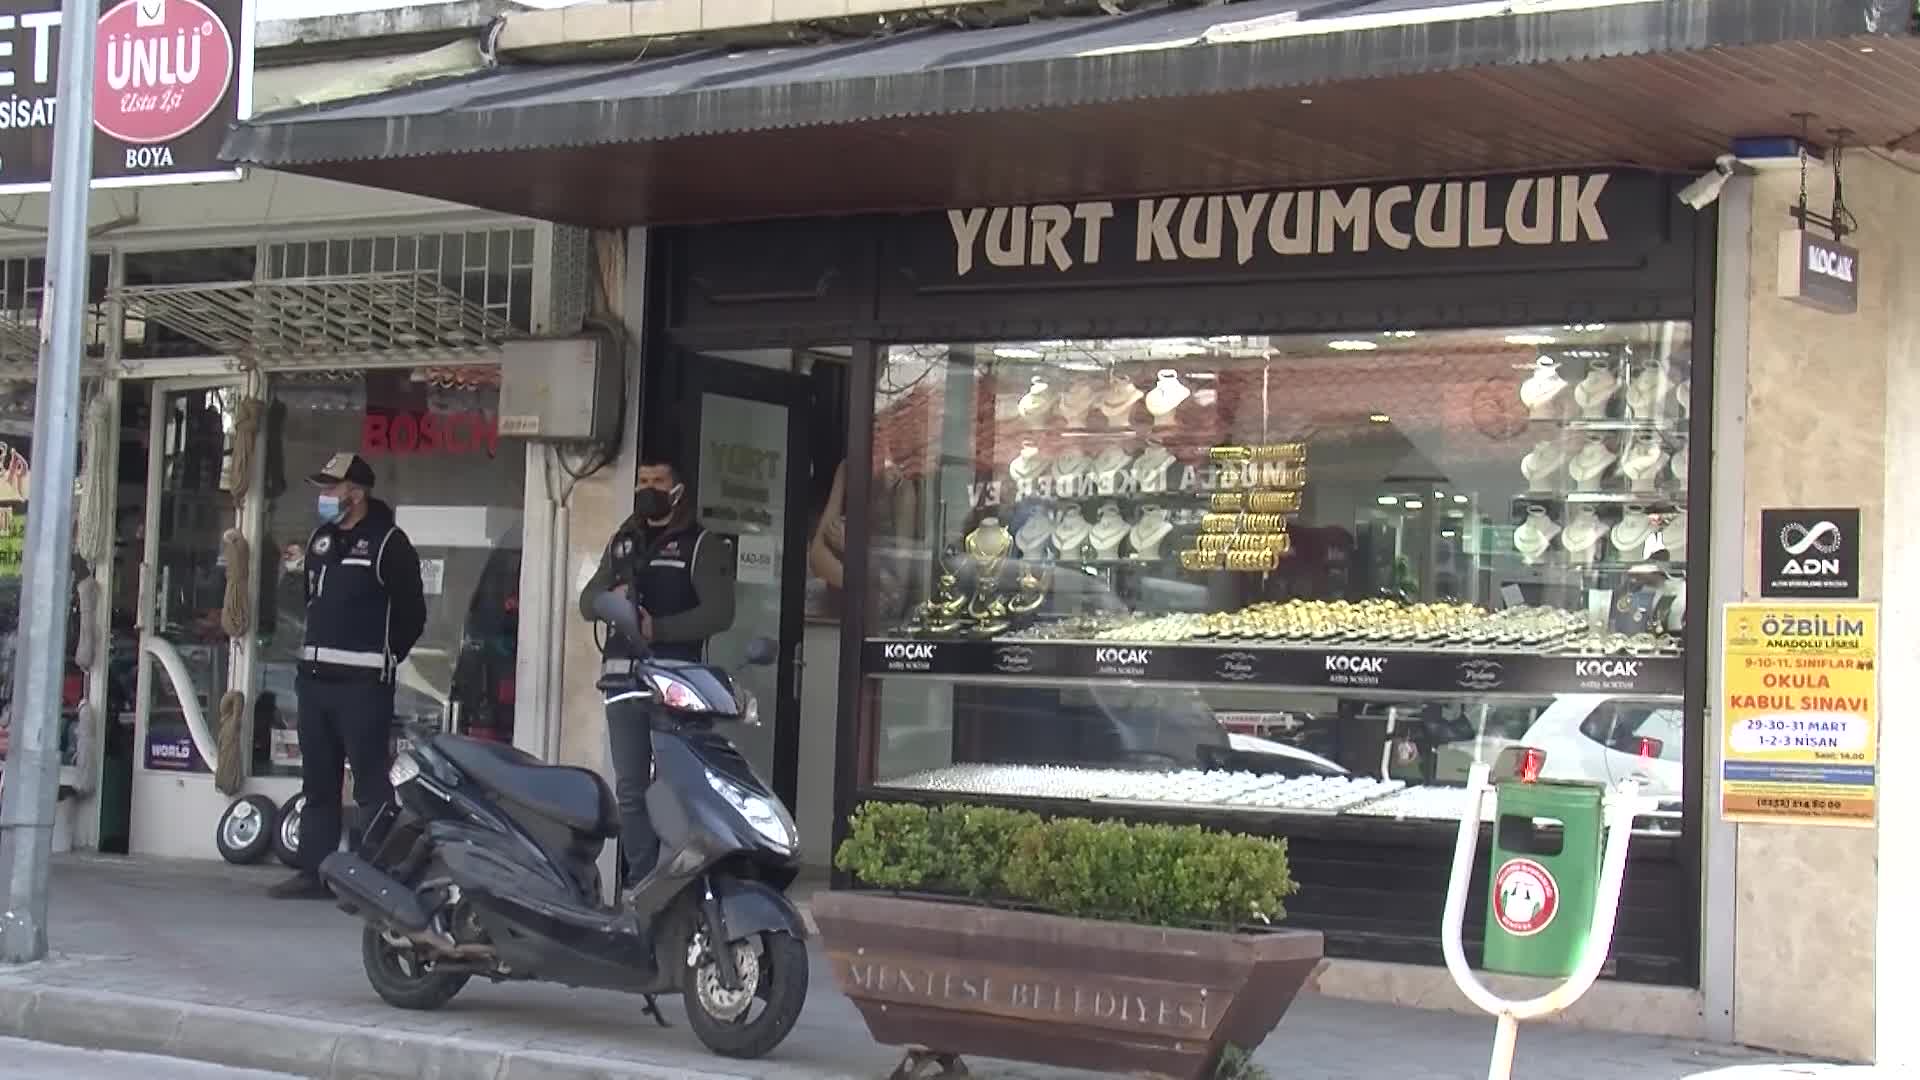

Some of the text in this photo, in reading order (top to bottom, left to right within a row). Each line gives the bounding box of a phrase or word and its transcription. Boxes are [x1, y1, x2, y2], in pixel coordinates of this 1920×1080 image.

[107, 27, 201, 90] ÜNLÜ
[120, 92, 158, 113] Usta
[126, 148, 174, 169] BOYA
[948, 173, 1611, 276] YURT KUYUMCULUK
[363, 413, 499, 455] BOSCH
[1781, 558, 1840, 575] ADN
[1762, 613, 1864, 637] ÖZBİLİM
[1766, 640, 1822, 649] ANADOLU
[1825, 638, 1859, 649] LİSESİ
[885, 644, 934, 660] KOÇAK
[1096, 648, 1149, 664] KOÇAK
[1325, 656, 1383, 673] KOÇAK
[1576, 661, 1639, 678] KOÇAK
[1795, 658, 1854, 669] SINIFLAR
[1763, 673, 1830, 688] OKULA
[1730, 695, 1868, 711] KABUL SINAVI
[1747, 719, 1848, 732] 29-30-31 MART
[1759, 733, 1838, 747] 1-2-3 NİSAN
[152, 744, 190, 758] WORLD
